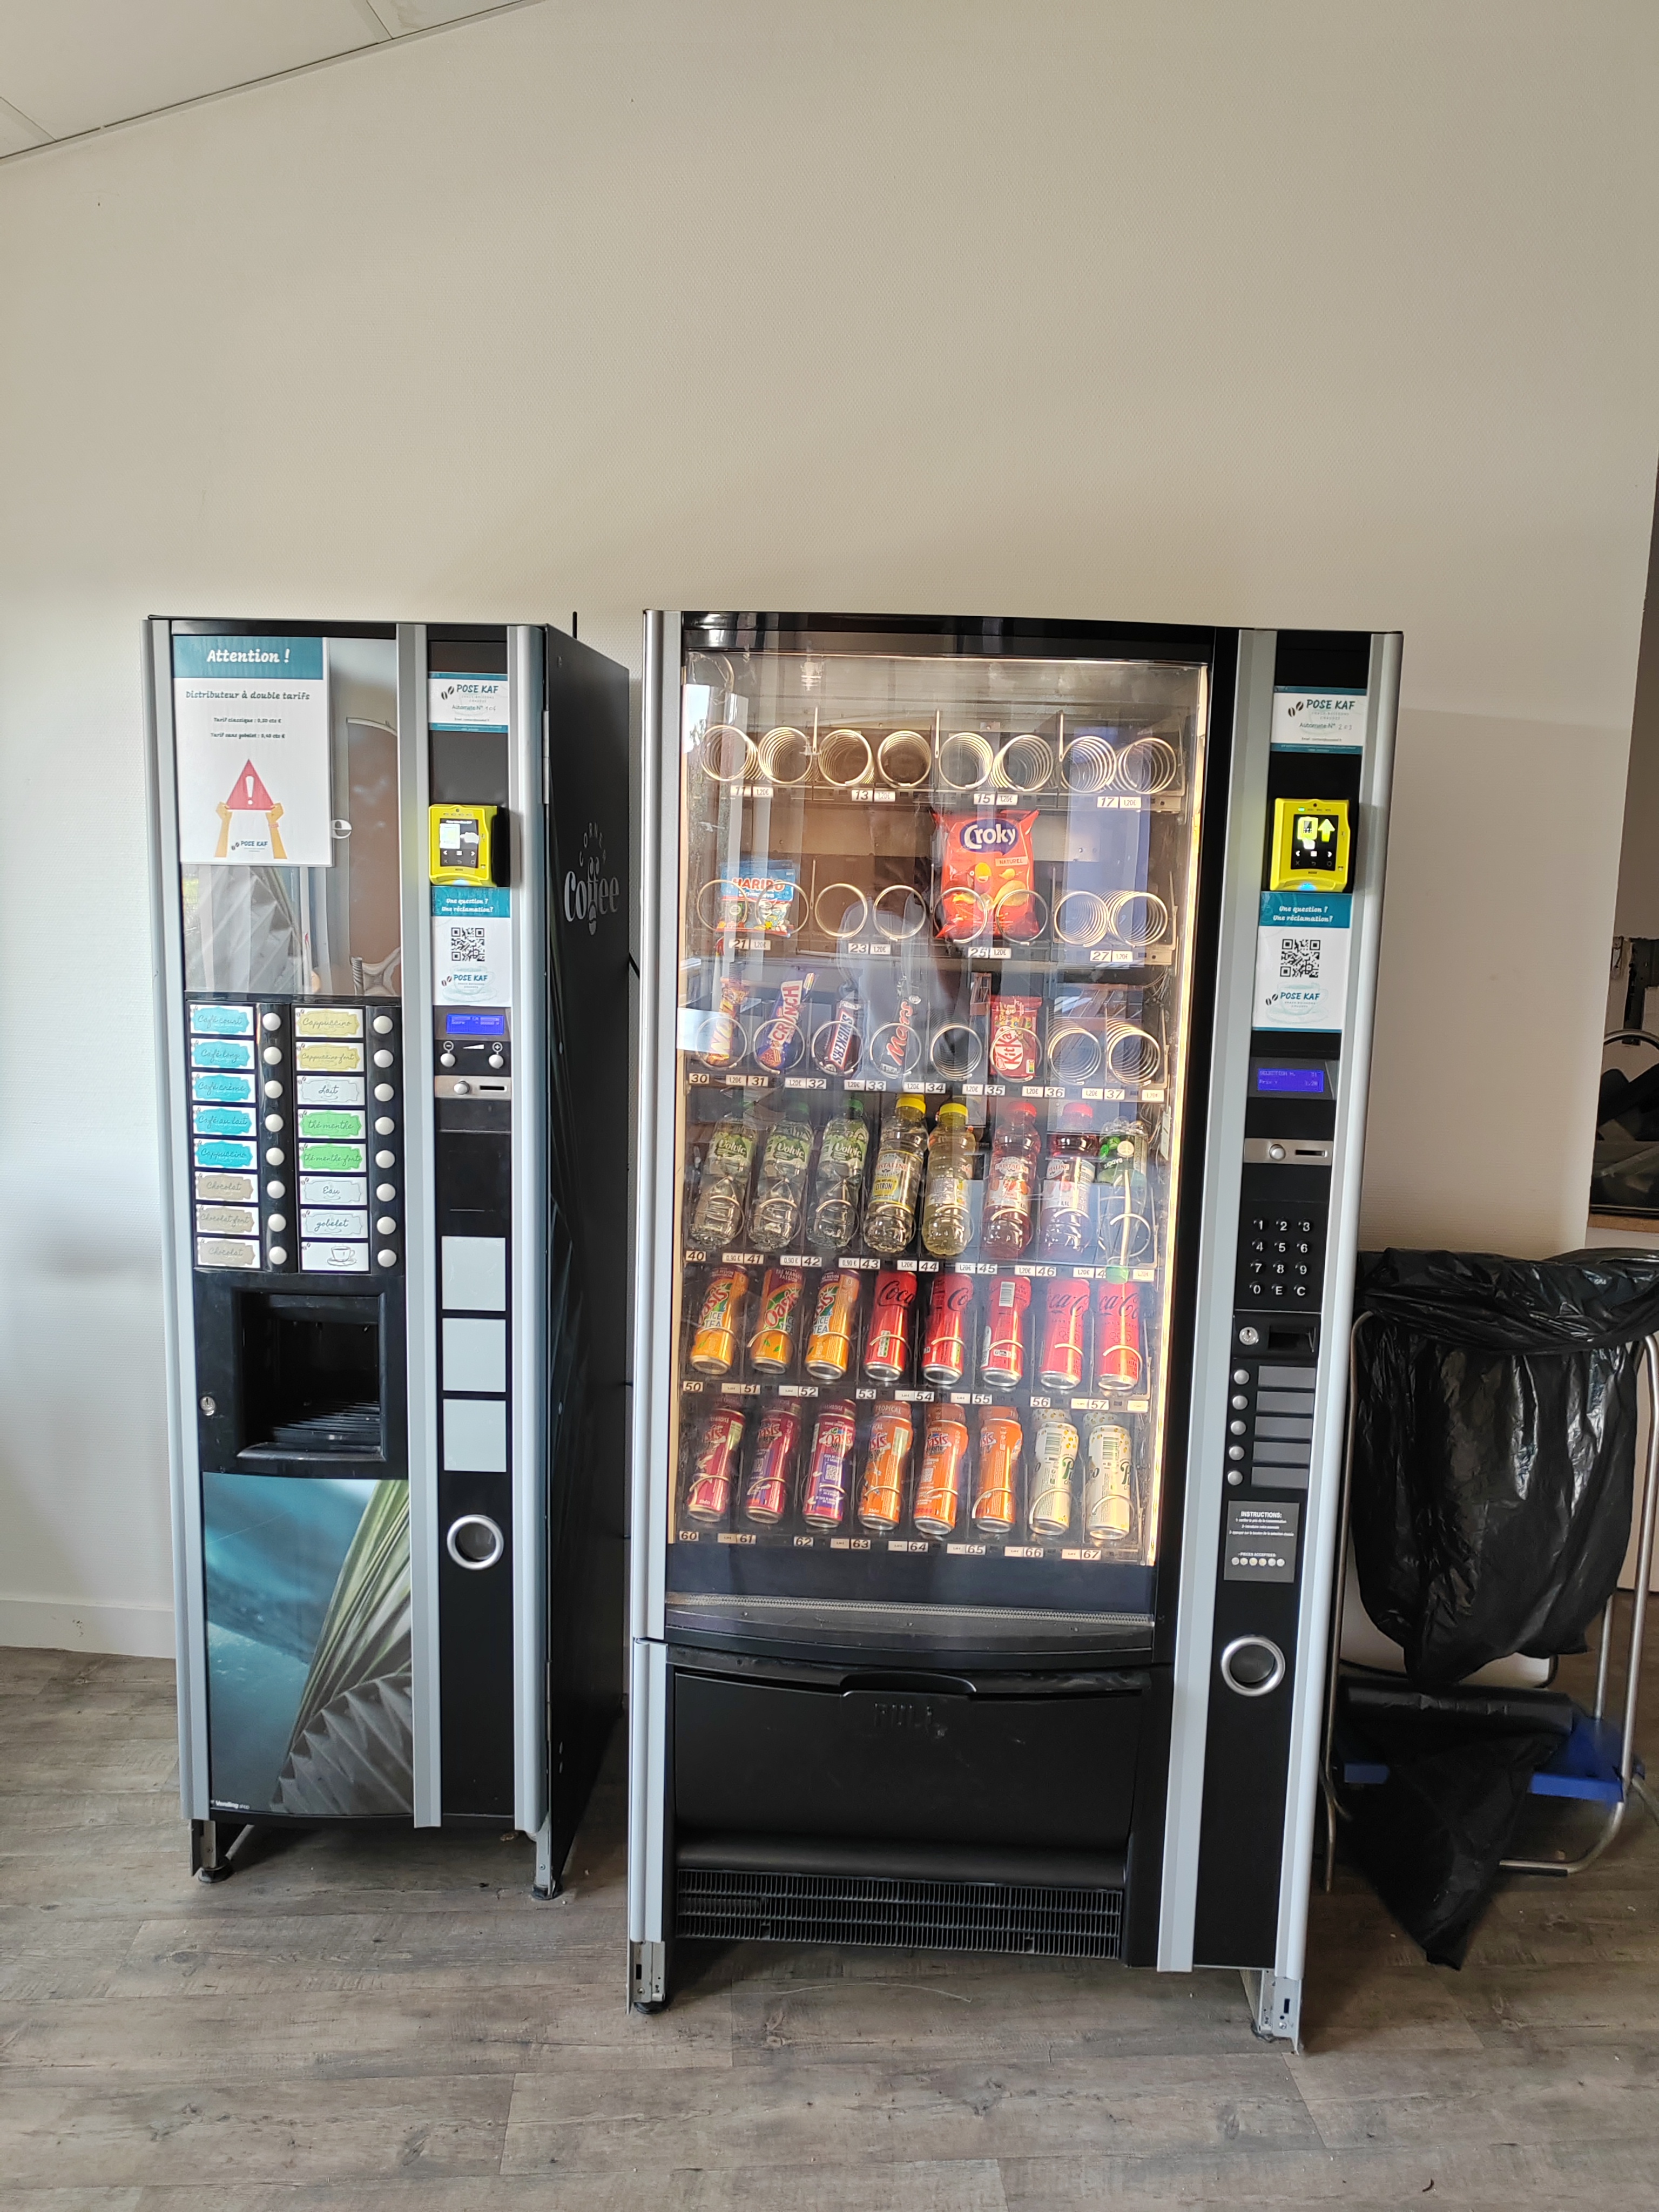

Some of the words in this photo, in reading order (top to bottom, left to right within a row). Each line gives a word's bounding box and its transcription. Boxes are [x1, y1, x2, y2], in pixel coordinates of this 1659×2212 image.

[206, 649, 280, 663] Attention
[284, 648, 291, 663] !
[456, 684, 479, 693] POSE
[481, 685, 498, 693] KAF
[186, 691, 239, 699] Distributeur
[242, 691, 248, 699] à
[283, 692, 310, 700] tarifs
[1306, 699, 1333, 709] POSE
[1334, 700, 1355, 710] KAF
[735, 786, 747, 795] 11
[855, 791, 868, 800] 13
[978, 794, 990, 804] 15
[1101, 797, 1114, 806] 17
[964, 824, 1016, 849] Croky
[564, 857, 619, 922] Coffee
[733, 878, 785, 892] HARIBO
[734, 940, 745, 948] 21
[850, 944, 866, 953] 23
[970, 948, 987, 957] 25
[1092, 952, 1109, 961] 27
[1280, 992, 1301, 1000] POSE
[198, 1015, 219, 1028] Café
[219, 1017, 242, 1025] court
[302, 1017, 352, 1029] Cappuccino
[886, 1001, 913, 1066] Mars
[832, 1013, 854, 1065] SNICKERS
[201, 1049, 221, 1063] Café
[221, 1050, 240, 1062] long
[301, 1051, 338, 1060] Cappuccino
[338, 1054, 354, 1064] fort
[691, 1074, 707, 1083] 30
[752, 1076, 765, 1086] 31
[198, 1082, 218, 1095] Café
[218, 1083, 245, 1091] crème
[808, 1080, 825, 1089] 32
[868, 1082, 885, 1091] 33
[927, 1083, 944, 1092] 34
[318, 1085, 339, 1094] Lait
[987, 1085, 1003, 1095] 35
[1047, 1088, 1063, 1097] 36
[1107, 1090, 1123, 1099] 37
[198, 1115, 219, 1129] Café
[232, 1115, 248, 1125] lait
[308, 1120, 322, 1129] thé
[322, 1120, 353, 1130] menthe
[718, 1139, 746, 1154] Volvic
[778, 1142, 805, 1158] Volvic
[836, 1142, 862, 1157] Volvic
[200, 1148, 247, 1158] Cappuccino
[316, 1153, 341, 1161] menthe
[341, 1155, 360, 1166] fort
[206, 1181, 242, 1191] Chocolat
[322, 1186, 341, 1195] Eau
[200, 1213, 232, 1222] Chocolat
[231, 1215, 250, 1228] fort
[314, 1219, 349, 1232] gobelet
[1259, 1220, 1263, 1230] 1
[1279, 1221, 1287, 1231] 2
[1303, 1222, 1310, 1231] 3
[208, 1246, 244, 1257] Chocolat
[1256, 1242, 1263, 1251] 4
[1278, 1243, 1286, 1252] 5
[1300, 1243, 1307, 1253] 6
[687, 1251, 705, 1261] 40
[747, 1255, 761, 1264] 41
[804, 1257, 821, 1266] 42
[862, 1259, 879, 1269] 43
[921, 1262, 938, 1271] 44
[979, 1264, 996, 1273] 45
[1255, 1263, 1263, 1273] 7
[1276, 1264, 1284, 1273] 8
[1299, 1265, 1307, 1274] 9
[1037, 1267, 1055, 1276] 46
[1097, 1270, 1107, 1278] 4
[779, 1274, 798, 1283] PASSION
[1253, 1285, 1261, 1294] 0
[1275, 1286, 1283, 1295] E
[1297, 1286, 1306, 1296] C
[710, 1312, 723, 1320] ICE
[813, 1325, 828, 1334] TEA
[685, 1382, 702, 1391] 50
[744, 1384, 757, 1393] 51
[800, 1387, 817, 1396] 52
[858, 1390, 874, 1399] 53
[916, 1392, 932, 1401] 54
[974, 1395, 990, 1404] 55
[1033, 1398, 1049, 1406] 56
[1090, 1400, 1107, 1410] 57
[875, 1405, 901, 1414] TROPICAL
[825, 1433, 853, 1447] Oasis
[681, 1532, 697, 1540] 60
[740, 1534, 753, 1543] 61
[795, 1537, 812, 1546] 62
[853, 1540, 869, 1549] 63
[910, 1542, 927, 1551] 64
[967, 1545, 984, 1554] 65
[1026, 1548, 1042, 1557] 66
[1083, 1550, 1100, 1559] 67
